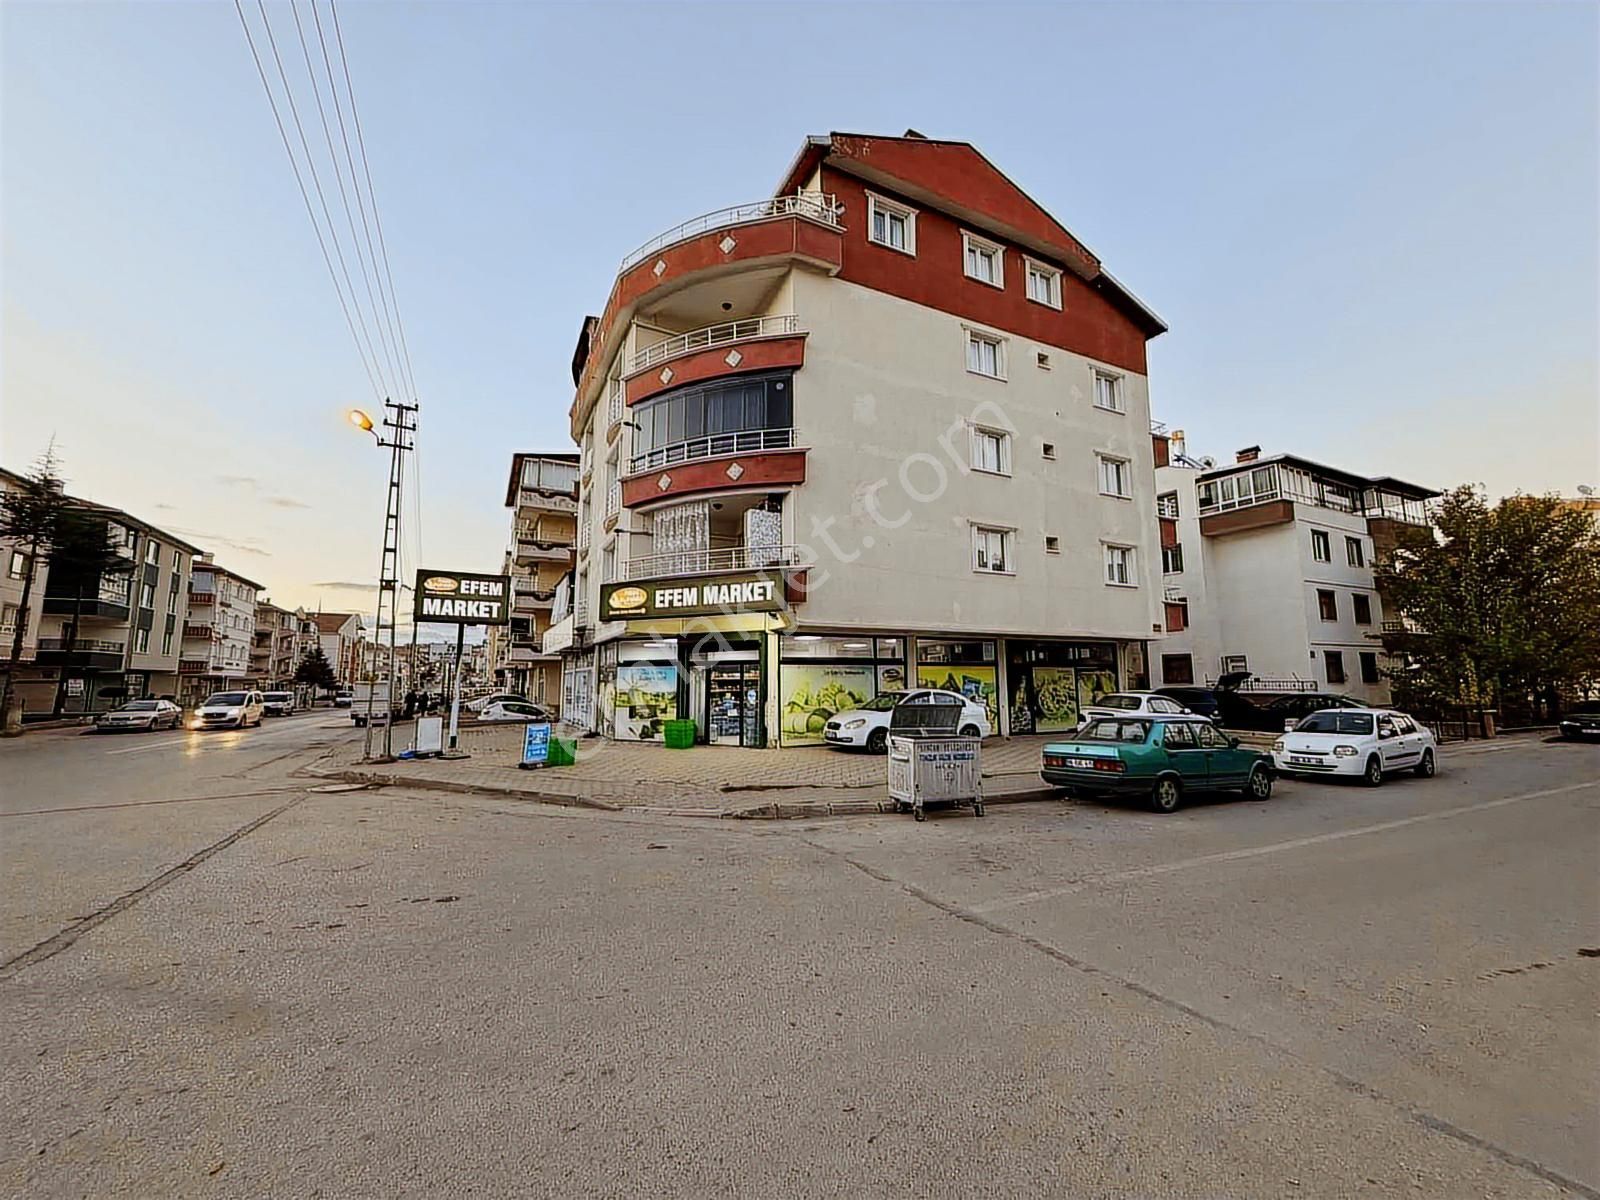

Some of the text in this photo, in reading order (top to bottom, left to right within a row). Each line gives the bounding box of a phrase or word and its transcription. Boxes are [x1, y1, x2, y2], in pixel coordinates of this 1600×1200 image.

[460, 579, 503, 596] EFEM
[654, 587, 698, 609] EFEM
[703, 581, 776, 605] MARKET
[422, 597, 502, 618] MARKET
